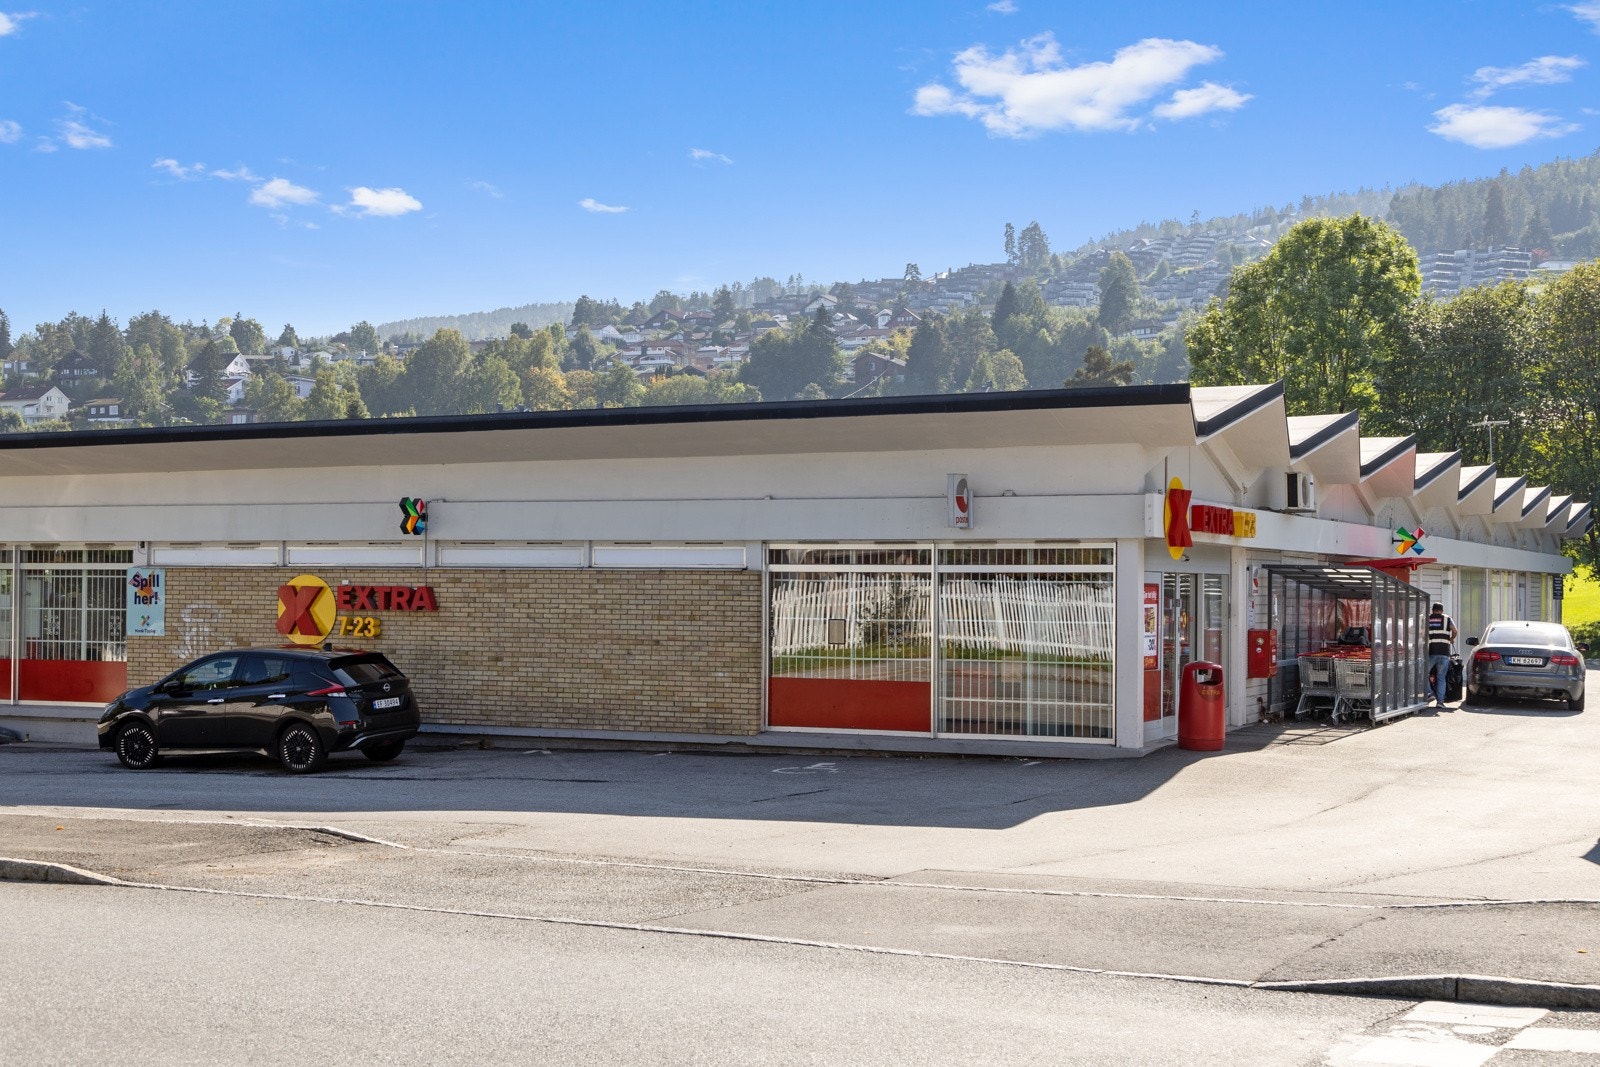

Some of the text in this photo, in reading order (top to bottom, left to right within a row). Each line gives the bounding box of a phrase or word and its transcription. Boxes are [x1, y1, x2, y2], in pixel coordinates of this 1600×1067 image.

[1200, 505, 1234, 536] EXTRA
[132, 574, 159, 590] Spill
[134, 592, 158, 604] her!
[337, 585, 438, 611] EXTRA
[276, 585, 324, 636] X
[338, 616, 379, 637] 7-23
